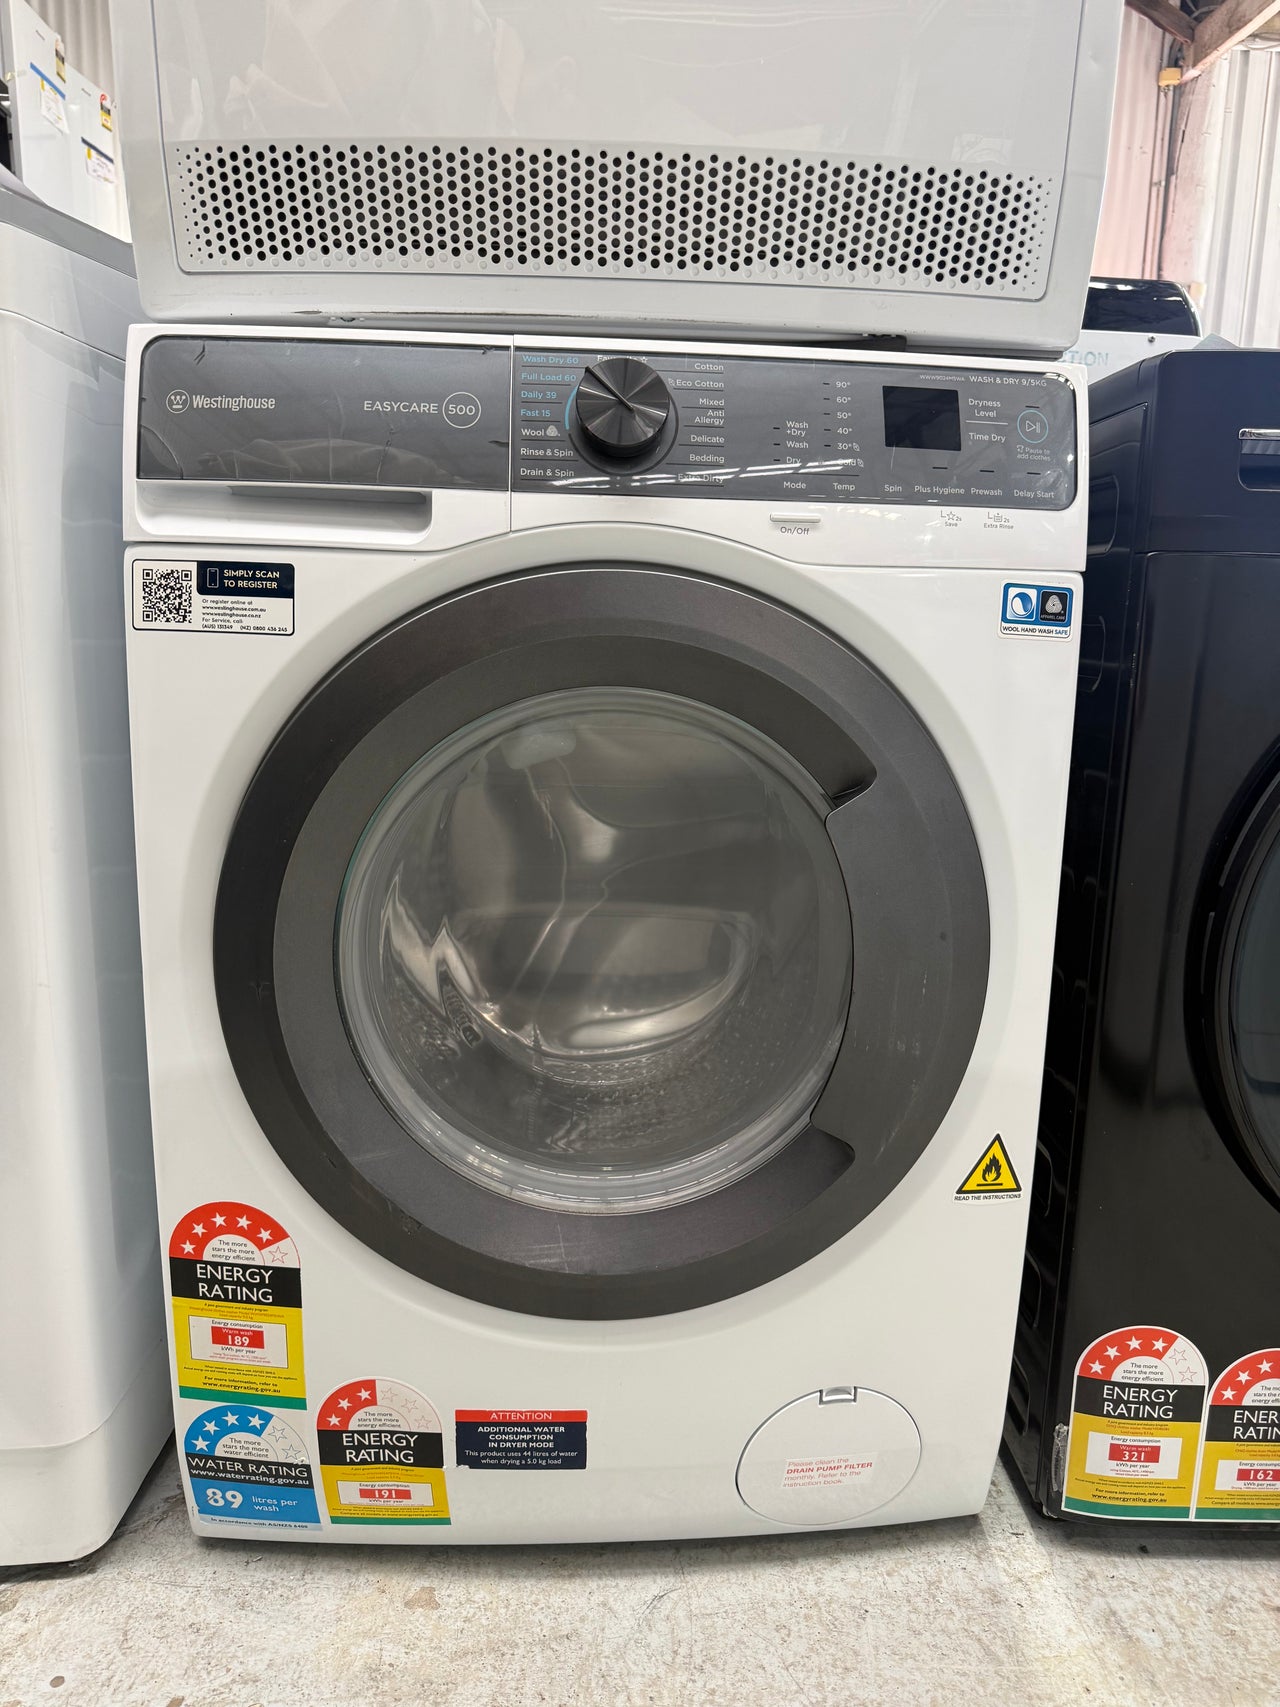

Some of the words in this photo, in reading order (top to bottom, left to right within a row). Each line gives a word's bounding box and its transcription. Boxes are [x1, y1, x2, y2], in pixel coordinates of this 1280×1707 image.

[522, 356, 546, 364] Wash
[548, 356, 566, 366] Dry
[1057, 350, 1109, 367] TION
[694, 363, 724, 371] Cotton
[521, 373, 538, 381] Full
[540, 373, 562, 381] Load
[564, 374, 577, 382] 60
[969, 375, 994, 384] WASH
[1003, 377, 1020, 385] DRY
[1022, 378, 1047, 387] 9/5KG
[695, 380, 724, 388] Cotton
[521, 391, 543, 399] Daily
[193, 394, 276, 412] Westinghouse
[699, 398, 724, 406] Mixed
[969, 399, 1001, 408] Dryness
[364, 400, 438, 414] EASYCARE
[448, 404, 475, 416] 500
[520, 409, 540, 417] Fast
[542, 409, 551, 417] 15
[694, 417, 724, 426] Allergy
[786, 421, 808, 429] Wash
[521, 428, 544, 437] Wool
[786, 429, 806, 437] +Dry
[690, 435, 725, 443] Delicate
[969, 433, 989, 441] Time
[991, 434, 1006, 443] Dry
[786, 441, 808, 449] Wash
[520, 448, 544, 456] Rinse
[553, 449, 574, 458] Spin
[689, 454, 725, 463] Bedding
[786, 457, 801, 465] Dry
[520, 468, 544, 476] Drain
[546, 469, 552, 477] &
[555, 469, 575, 478] Spin
[784, 481, 806, 489] Mode
[833, 482, 856, 491] Temp
[884, 484, 902, 493] Spin
[933, 486, 965, 495] Hygiene
[971, 488, 1003, 496] Prewash
[1014, 490, 1035, 499] Delay
[780, 526, 810, 535] On/Off
[224, 569, 253, 578] SIMPLY
[256, 571, 280, 579] SCAN
[238, 580, 278, 589] REGISTER
[196, 1264, 273, 1284] ENERGY
[198, 1282, 273, 1303] RATING
[230, 1321, 263, 1329] consumption
[227, 1336, 250, 1346] 189
[1103, 1385, 1178, 1402] ENERGY
[1103, 1401, 1173, 1419] RATING
[490, 1412, 552, 1420] ATTENTION
[1233, 1410, 1279, 1424] ENER
[342, 1433, 419, 1447] ENERGY
[346, 1449, 414, 1464] RATING
[1123, 1452, 1145, 1461] 321
[188, 1457, 246, 1472] WATER
[249, 1463, 308, 1477] RATING
[844, 1462, 873, 1470] FILTER
[190, 1468, 309, 1485] www.waterrating.gov.au
[1250, 1470, 1273, 1480] 162
[206, 1488, 243, 1509] 89
[251, 1496, 278, 1504] litres
[280, 1499, 298, 1507] per
[375, 1489, 396, 1499] 191
[254, 1504, 279, 1512] wash
